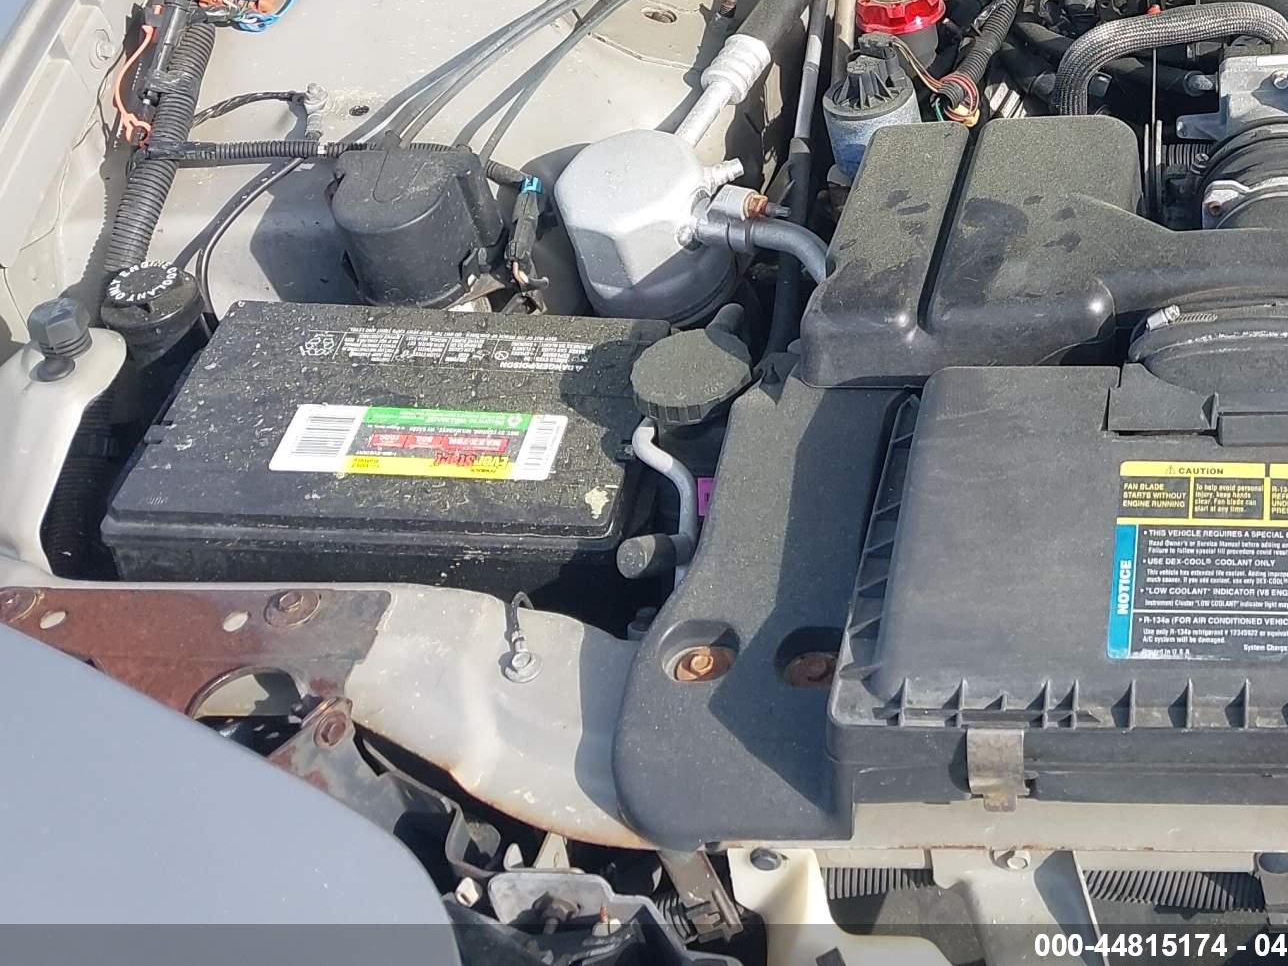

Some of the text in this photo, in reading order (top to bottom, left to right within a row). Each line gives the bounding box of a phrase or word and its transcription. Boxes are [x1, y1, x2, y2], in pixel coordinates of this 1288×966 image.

[126, 267, 178, 302] COOLANT
[1204, 484, 1218, 492] help
[1236, 484, 1264, 492] personal
[1216, 492, 1232, 500] keep
[1117, 560, 1132, 616] NOTICE
[1172, 616, 1192, 624] (FOR
[1208, 618, 1262, 626] CONDITIONED
[1244, 644, 1266, 652] System
